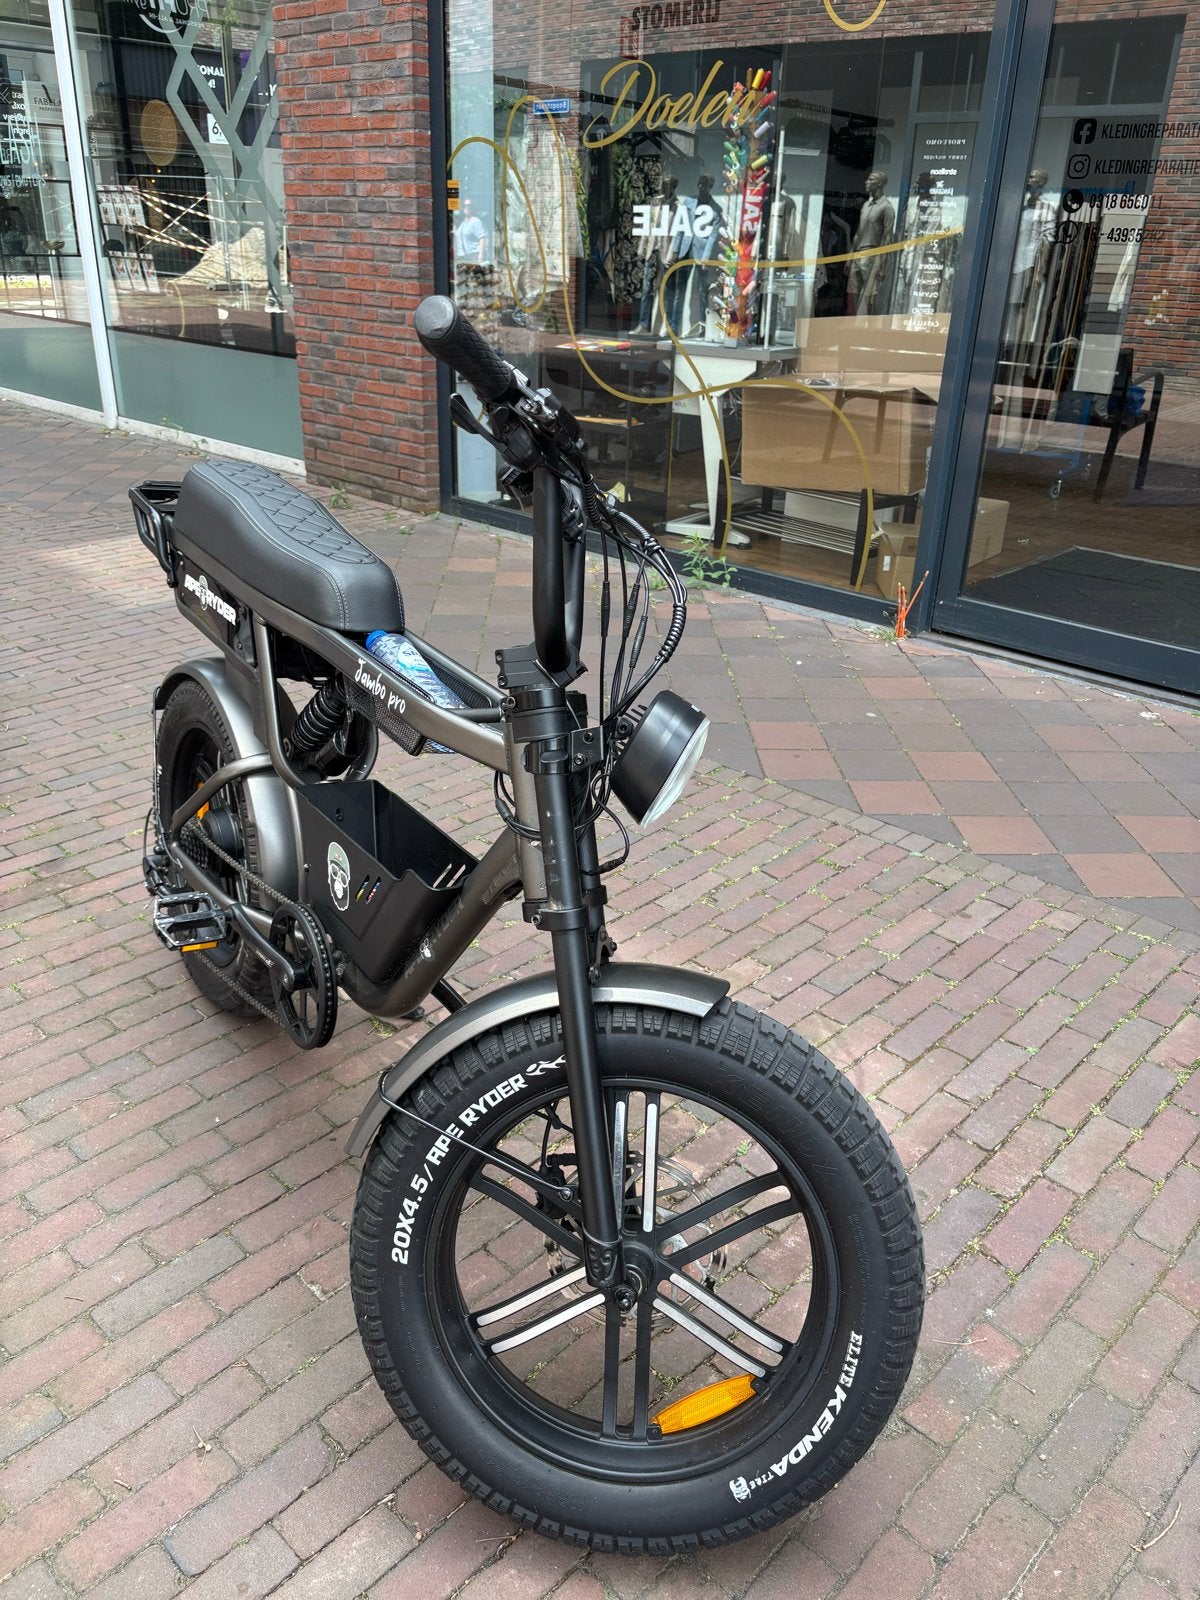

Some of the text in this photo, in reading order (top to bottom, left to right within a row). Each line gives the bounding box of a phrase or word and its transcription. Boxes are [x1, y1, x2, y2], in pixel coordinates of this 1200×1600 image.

[198, 64, 225, 76] ONAL
[1089, 194, 1117, 209] 0318
[387, 691, 406, 714] pro
[458, 1073, 529, 1128] RYDER
[839, 1330, 863, 1388] ELITE
[769, 1384, 847, 1477] KENDA
[748, 1470, 775, 1490] TIRE
